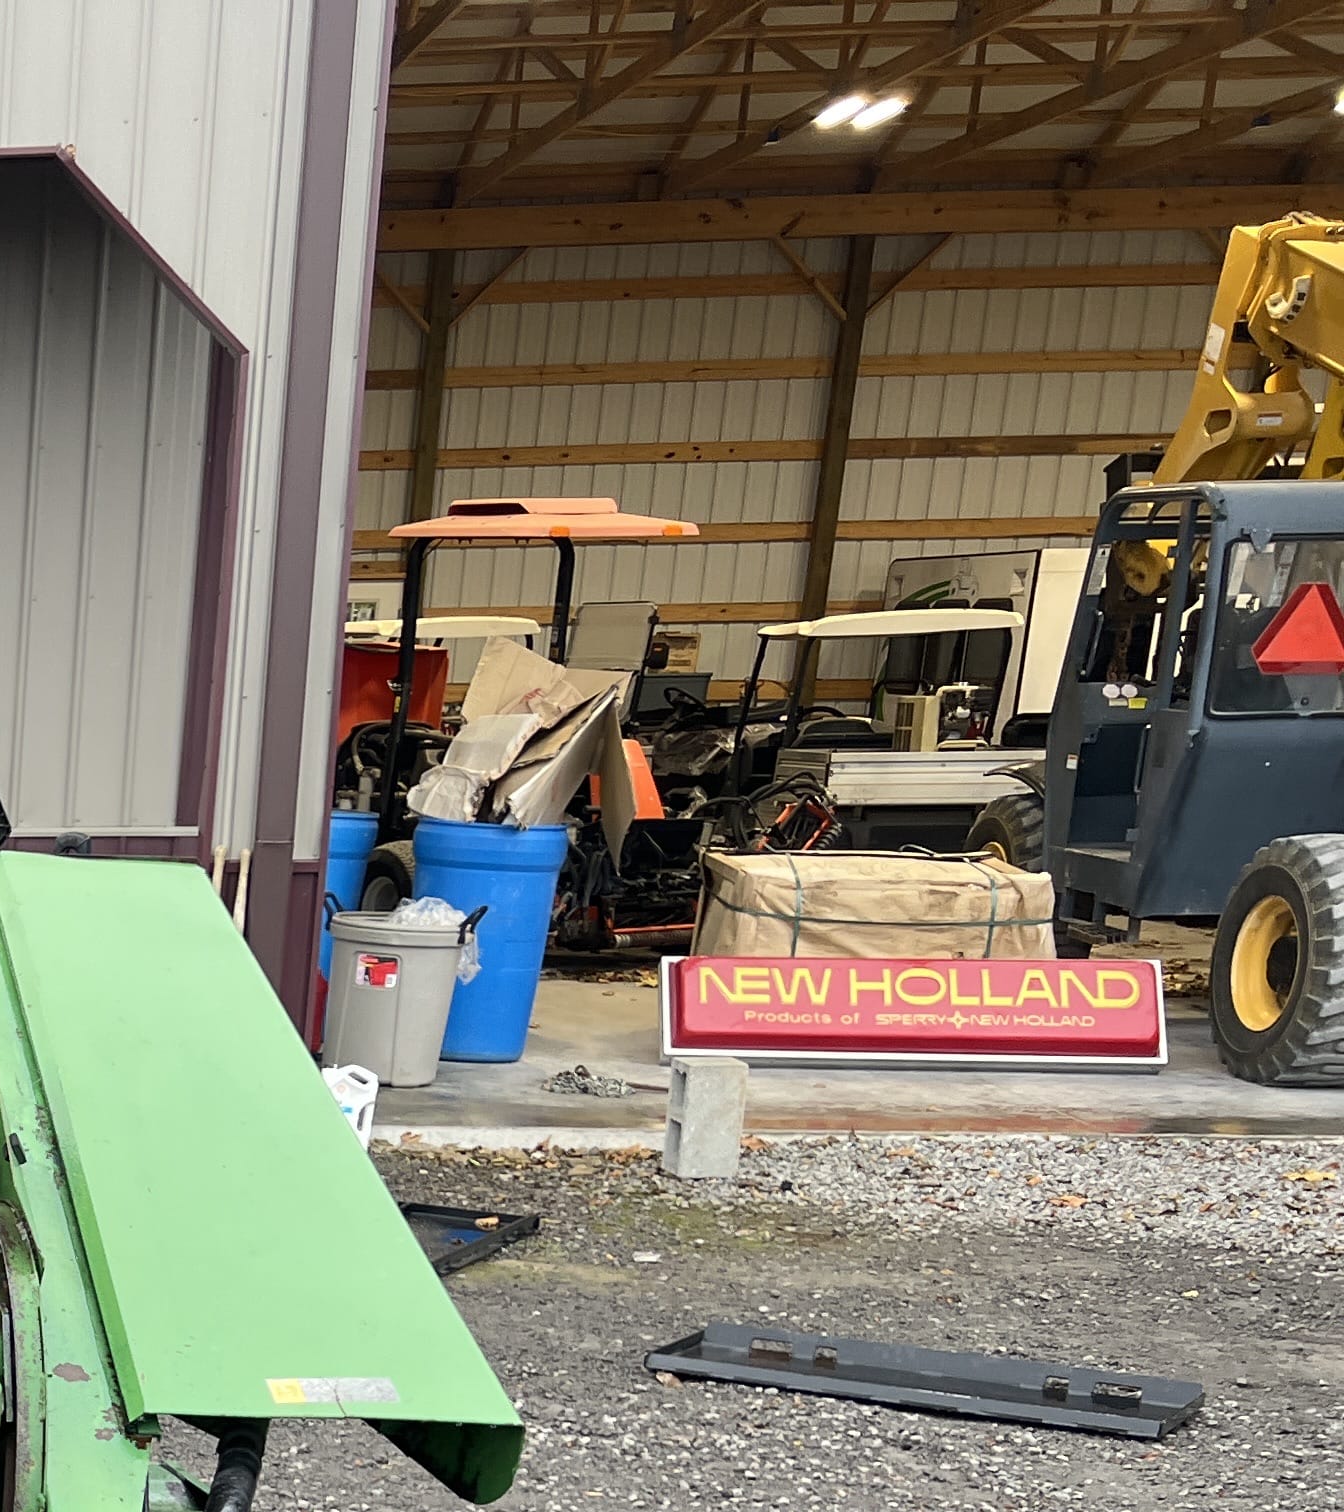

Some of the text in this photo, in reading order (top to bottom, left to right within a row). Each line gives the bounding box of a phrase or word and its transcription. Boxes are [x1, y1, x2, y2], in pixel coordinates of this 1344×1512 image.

[699, 966, 1141, 1009] NEW HOLLAND
[743, 1009, 1096, 1028] Products of SPERRY NEW HOLLAND
